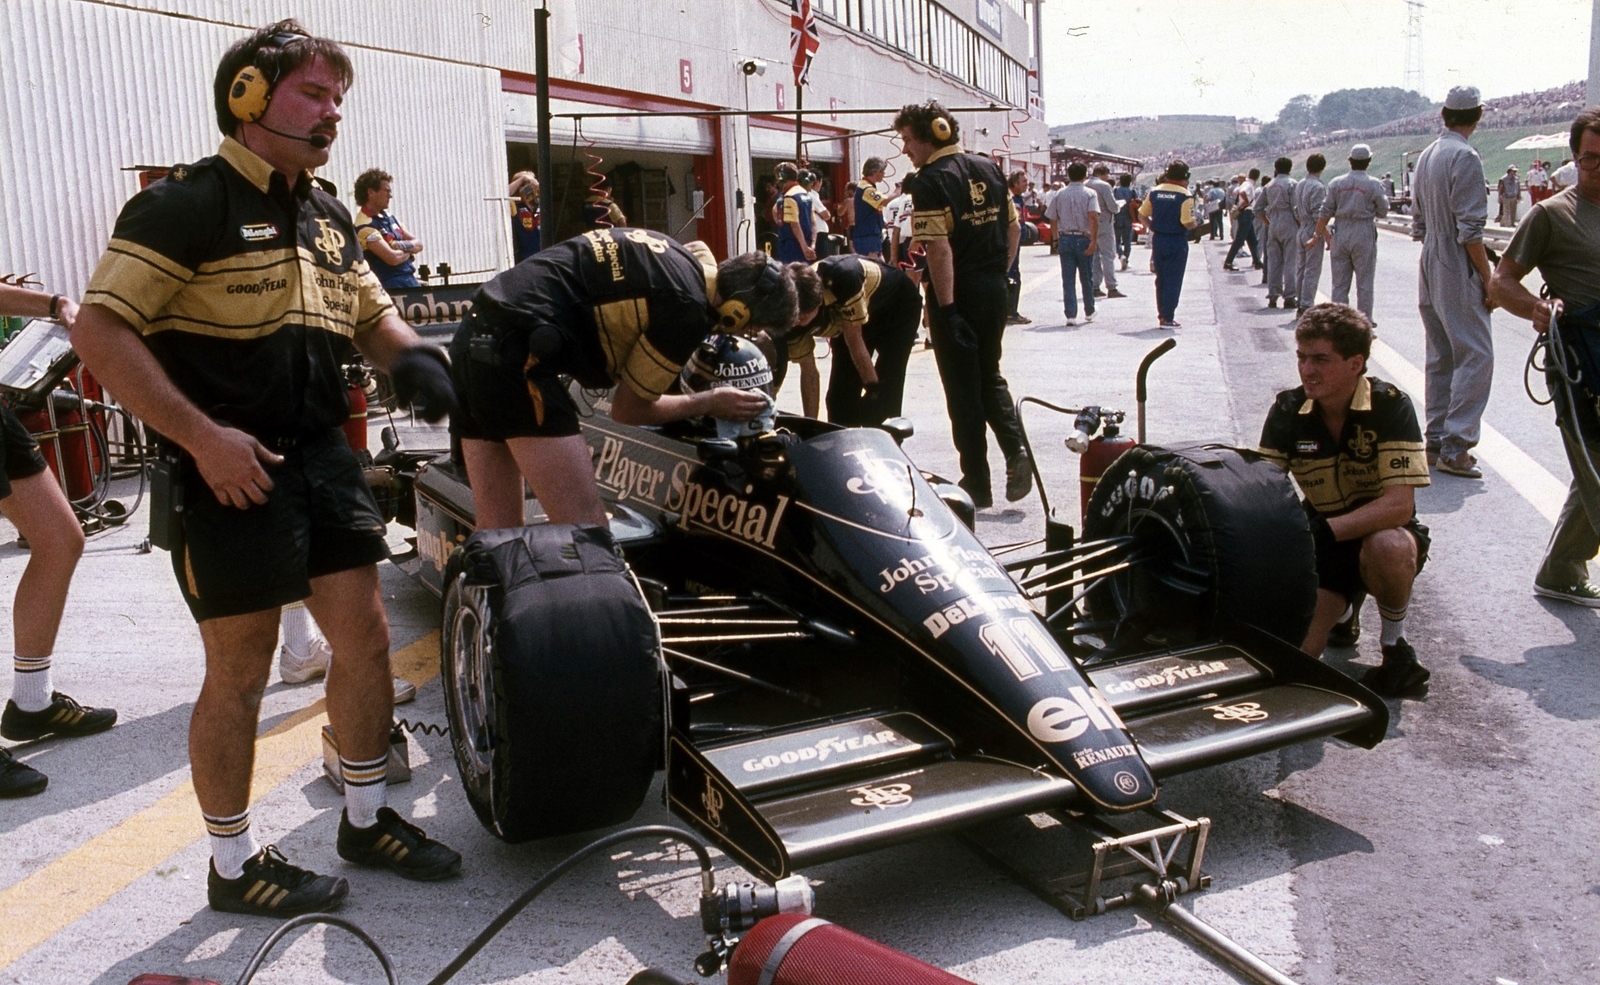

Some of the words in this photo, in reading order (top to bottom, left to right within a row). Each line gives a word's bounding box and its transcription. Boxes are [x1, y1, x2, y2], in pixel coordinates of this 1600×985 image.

[683, 65, 690, 88] 5
[914, 221, 928, 230] elf
[605, 242, 625, 282] Special
[226, 277, 287, 296] GOODYEAR
[314, 271, 335, 289] ohn
[323, 296, 352, 314] Special
[714, 362, 748, 378] John
[731, 374, 768, 388] RENAULT
[1389, 456, 1411, 470] elf
[595, 436, 665, 500] Player
[664, 461, 789, 550] Special
[979, 616, 1071, 682] 11
[1105, 661, 1229, 694] GOODYEAR
[1026, 686, 1128, 743] elf
[742, 730, 898, 773] GOODYEAR
[1075, 744, 1138, 770] RENAULT
